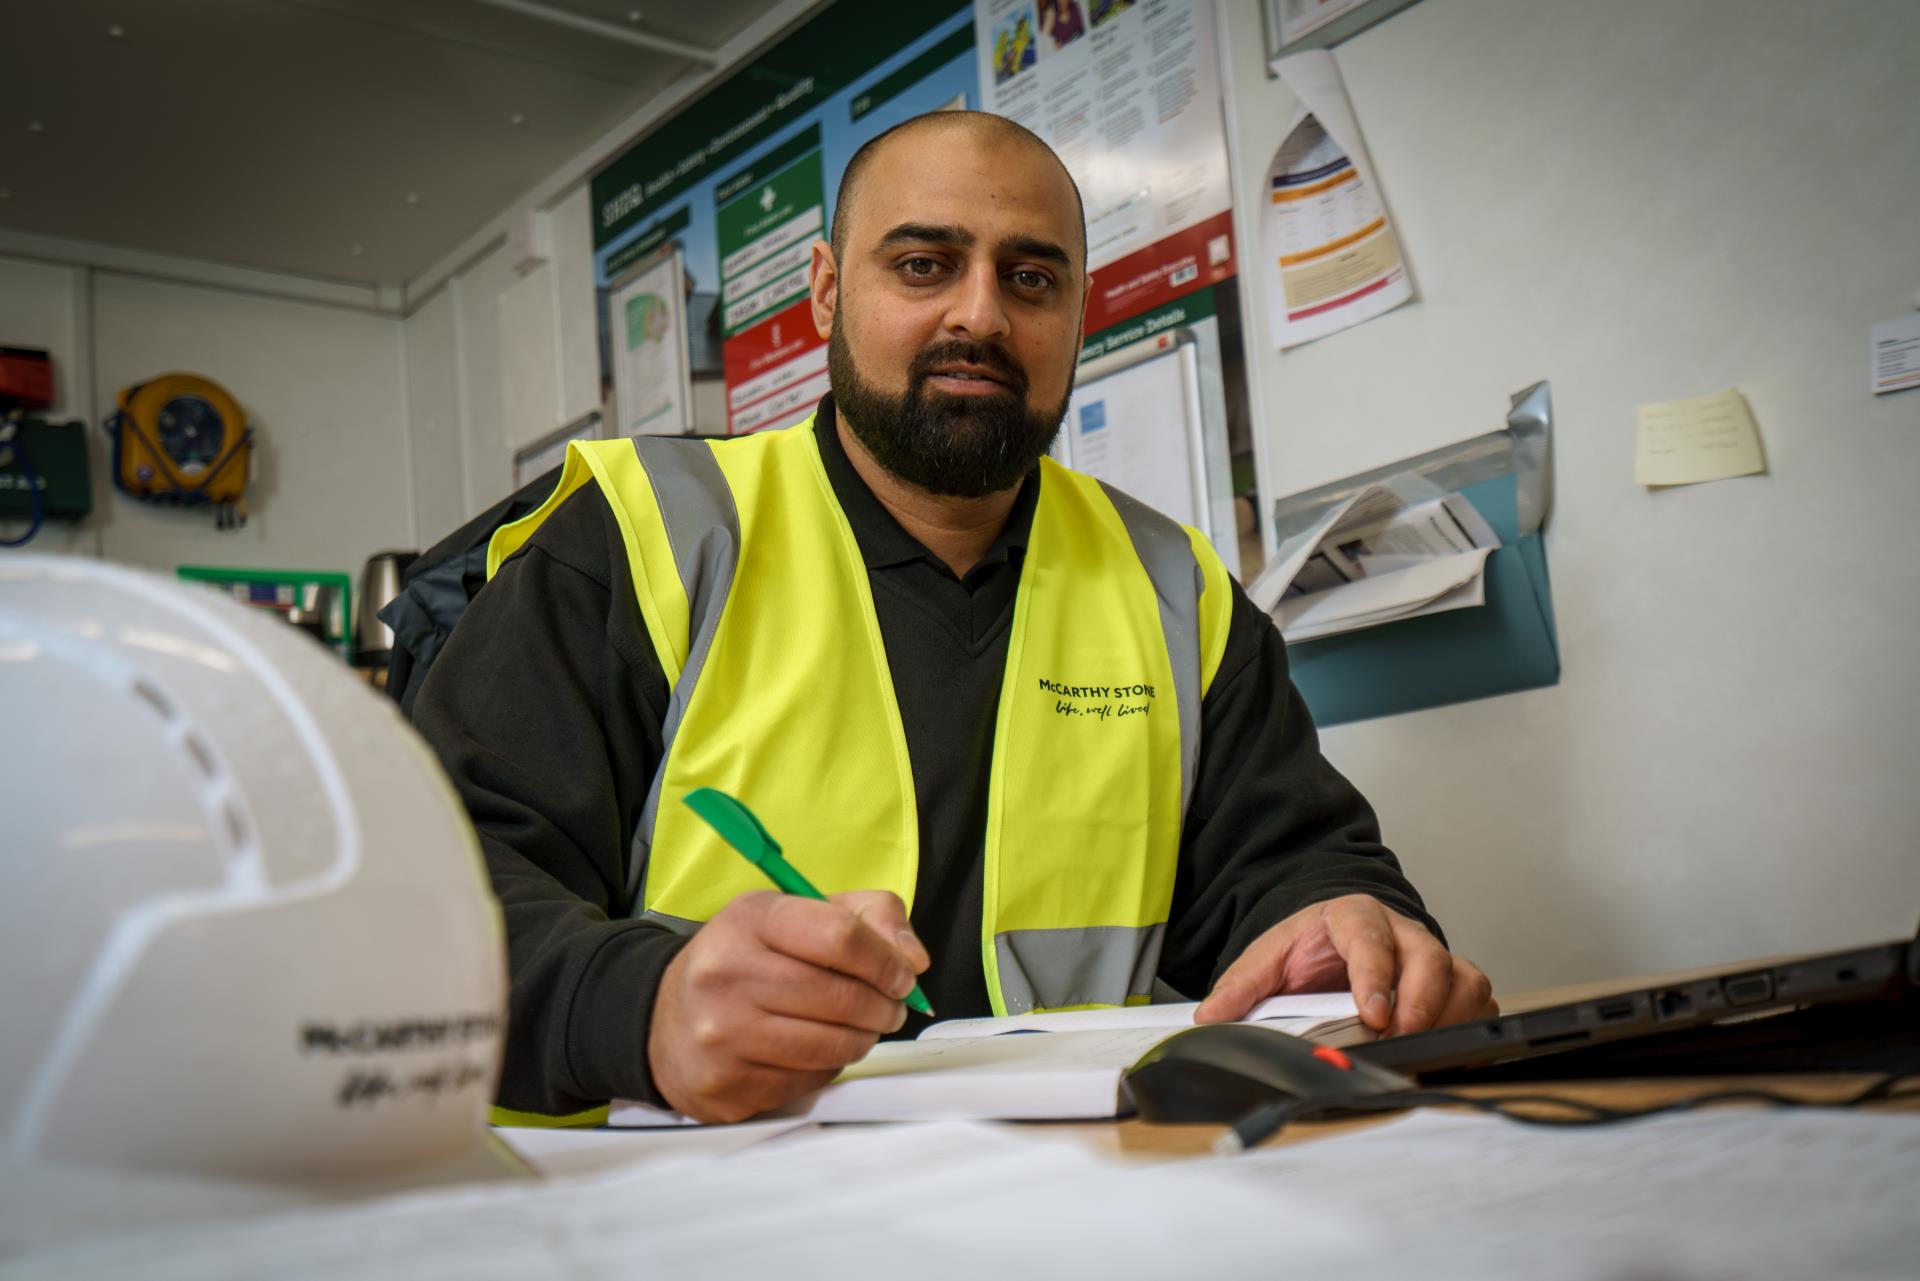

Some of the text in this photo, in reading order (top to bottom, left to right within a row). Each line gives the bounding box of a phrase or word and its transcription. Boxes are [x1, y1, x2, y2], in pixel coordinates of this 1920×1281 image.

[1105, 308, 1186, 351] Service Details
[1039, 678, 1156, 699] McCARTHY STONE
